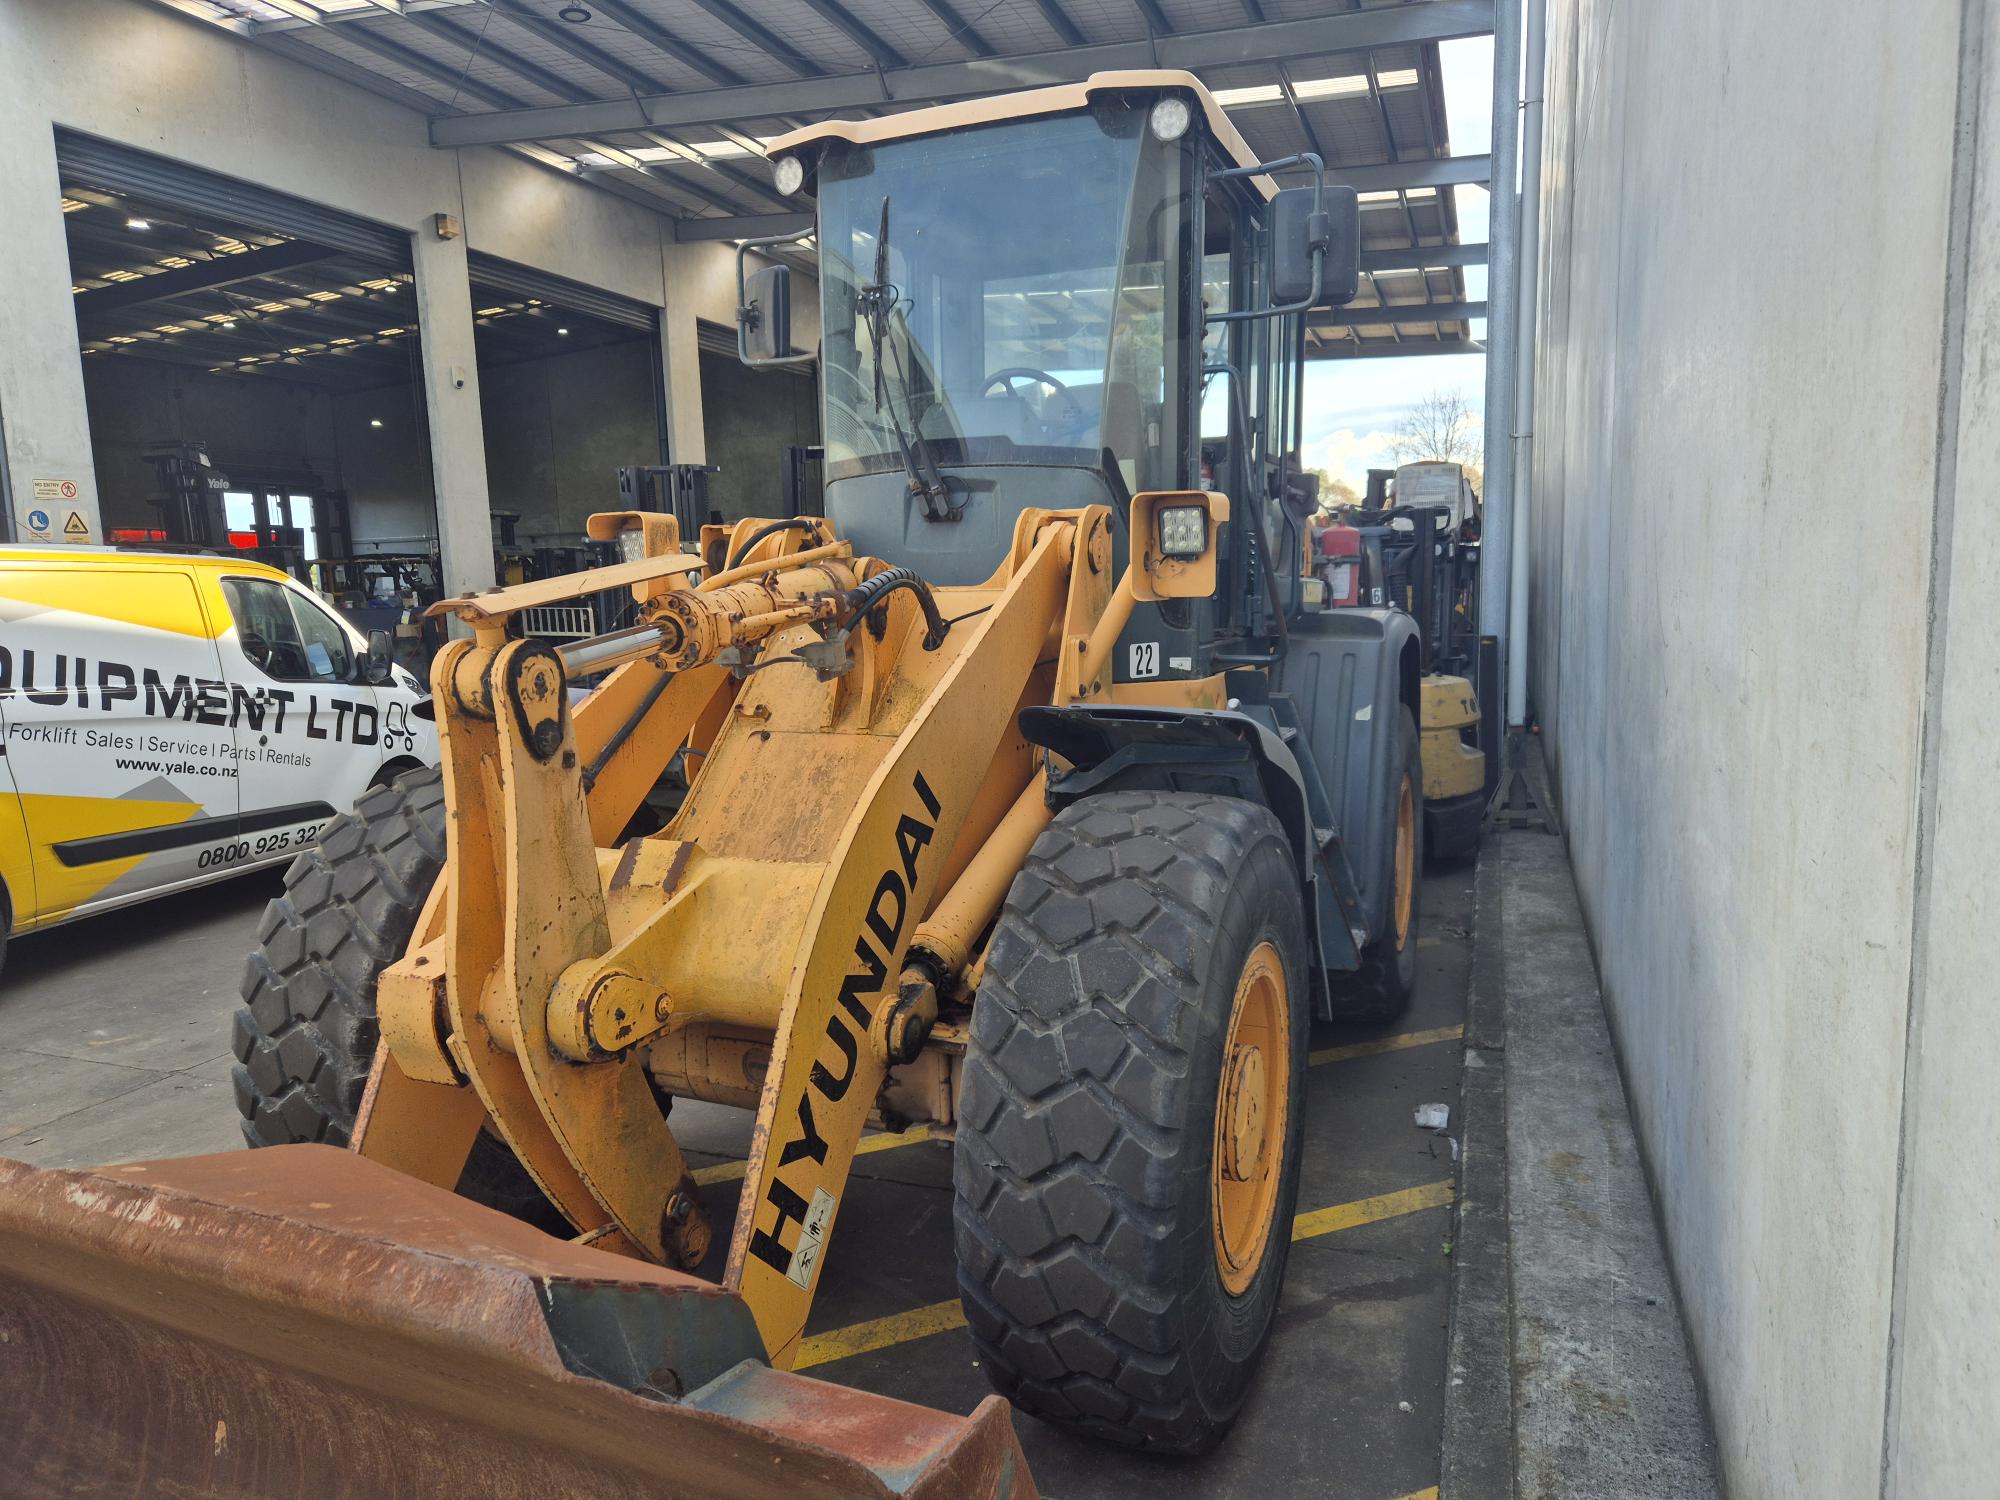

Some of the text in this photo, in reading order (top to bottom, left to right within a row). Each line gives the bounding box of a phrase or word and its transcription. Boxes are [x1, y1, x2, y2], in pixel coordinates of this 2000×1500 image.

[208, 478, 230, 489] Yale
[1136, 644, 1153, 675] 22
[306, 695, 379, 746] LTD
[9, 722, 77, 744] Forklift
[85, 730, 134, 749] Sales
[147, 736, 208, 756] Service
[220, 746, 256, 761] Parts
[266, 750, 311, 767] Rentals
[115, 759, 238, 777] www.yale.co.nz
[197, 823, 327, 869] 0800 925 32
[748, 769, 941, 1275] HYUNDAI
